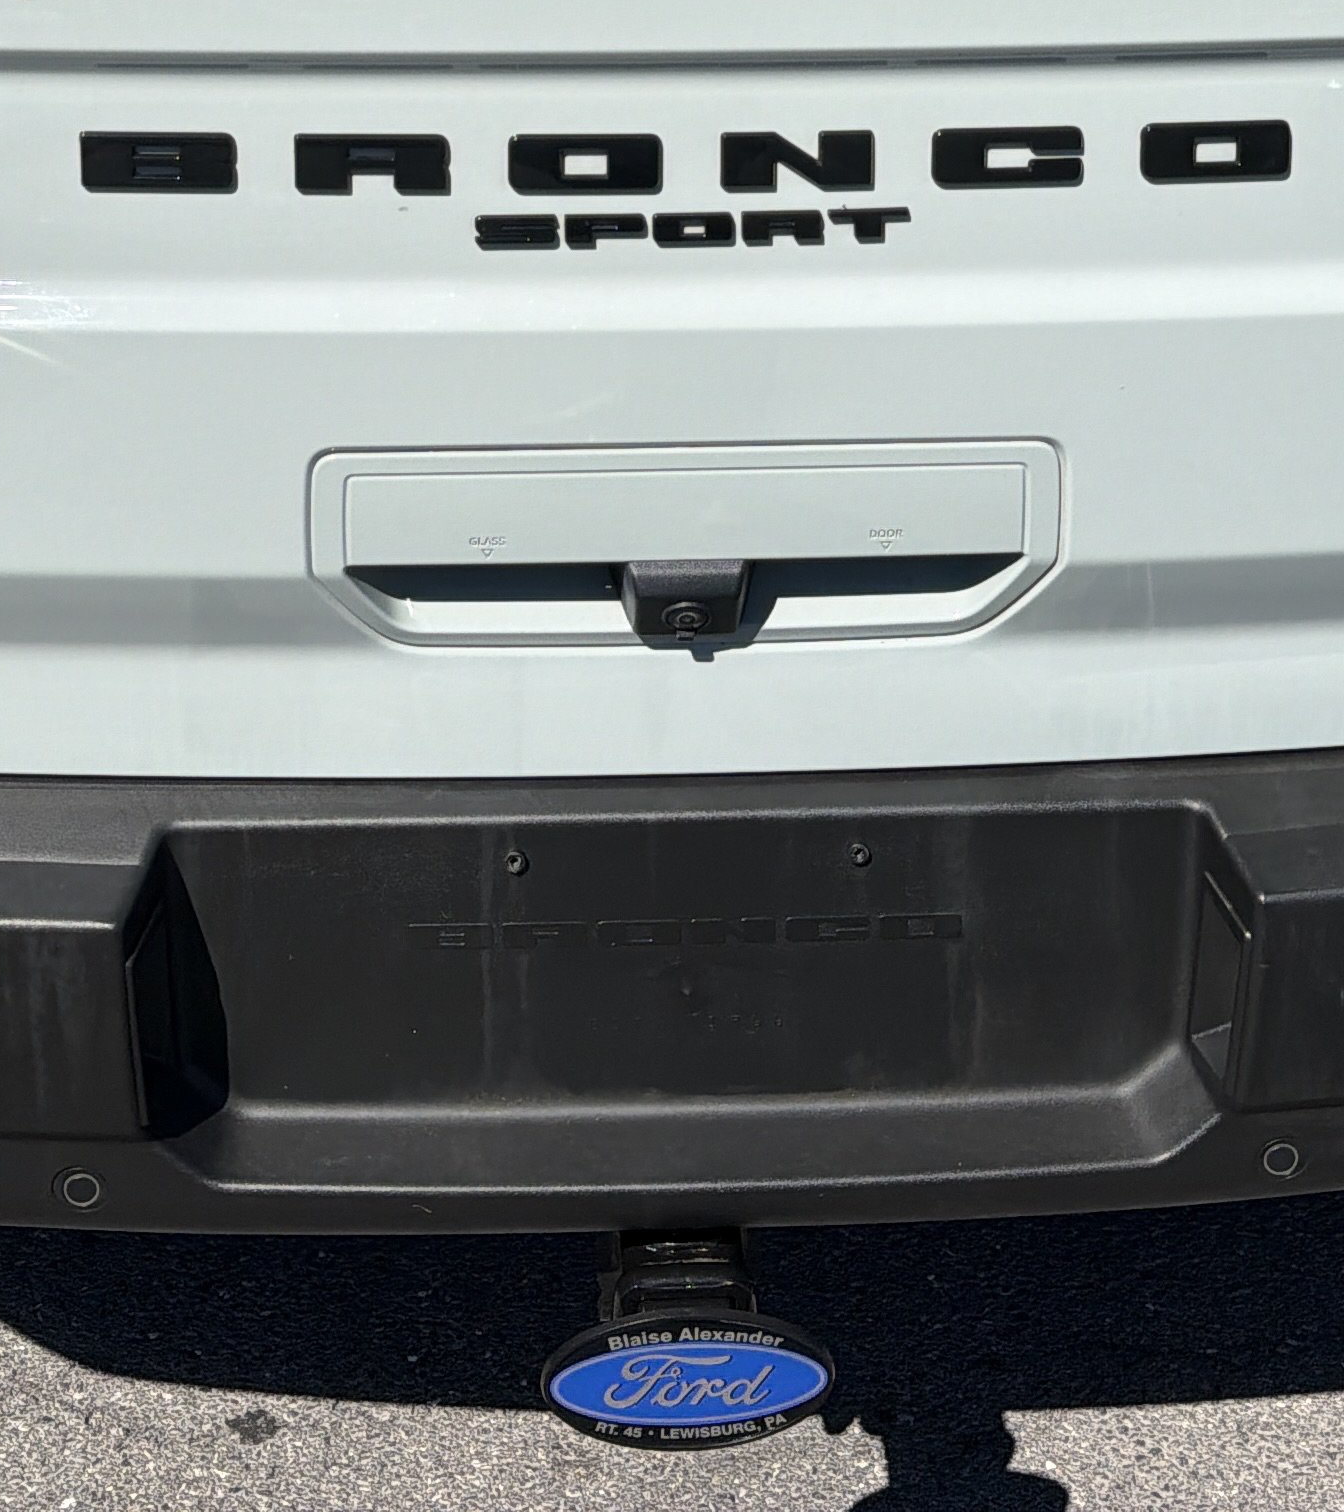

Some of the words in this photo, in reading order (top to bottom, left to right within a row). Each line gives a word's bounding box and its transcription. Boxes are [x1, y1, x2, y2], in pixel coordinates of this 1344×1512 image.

[79, 119, 1293, 196] BRONCO
[474, 205, 912, 250] SPORT
[468, 536, 507, 546] GLASS
[869, 528, 904, 539] DOOR
[408, 911, 963, 949] BRONCO
[607, 1328, 673, 1352] Blaise
[679, 1327, 785, 1348] Alexander
[603, 1353, 775, 1409] Ford
[593, 1420, 620, 1437] RT.
[624, 1425, 643, 1439] 45
[660, 1418, 764, 1440] LEWISBURG,
[766, 1412, 788, 1431] PA
